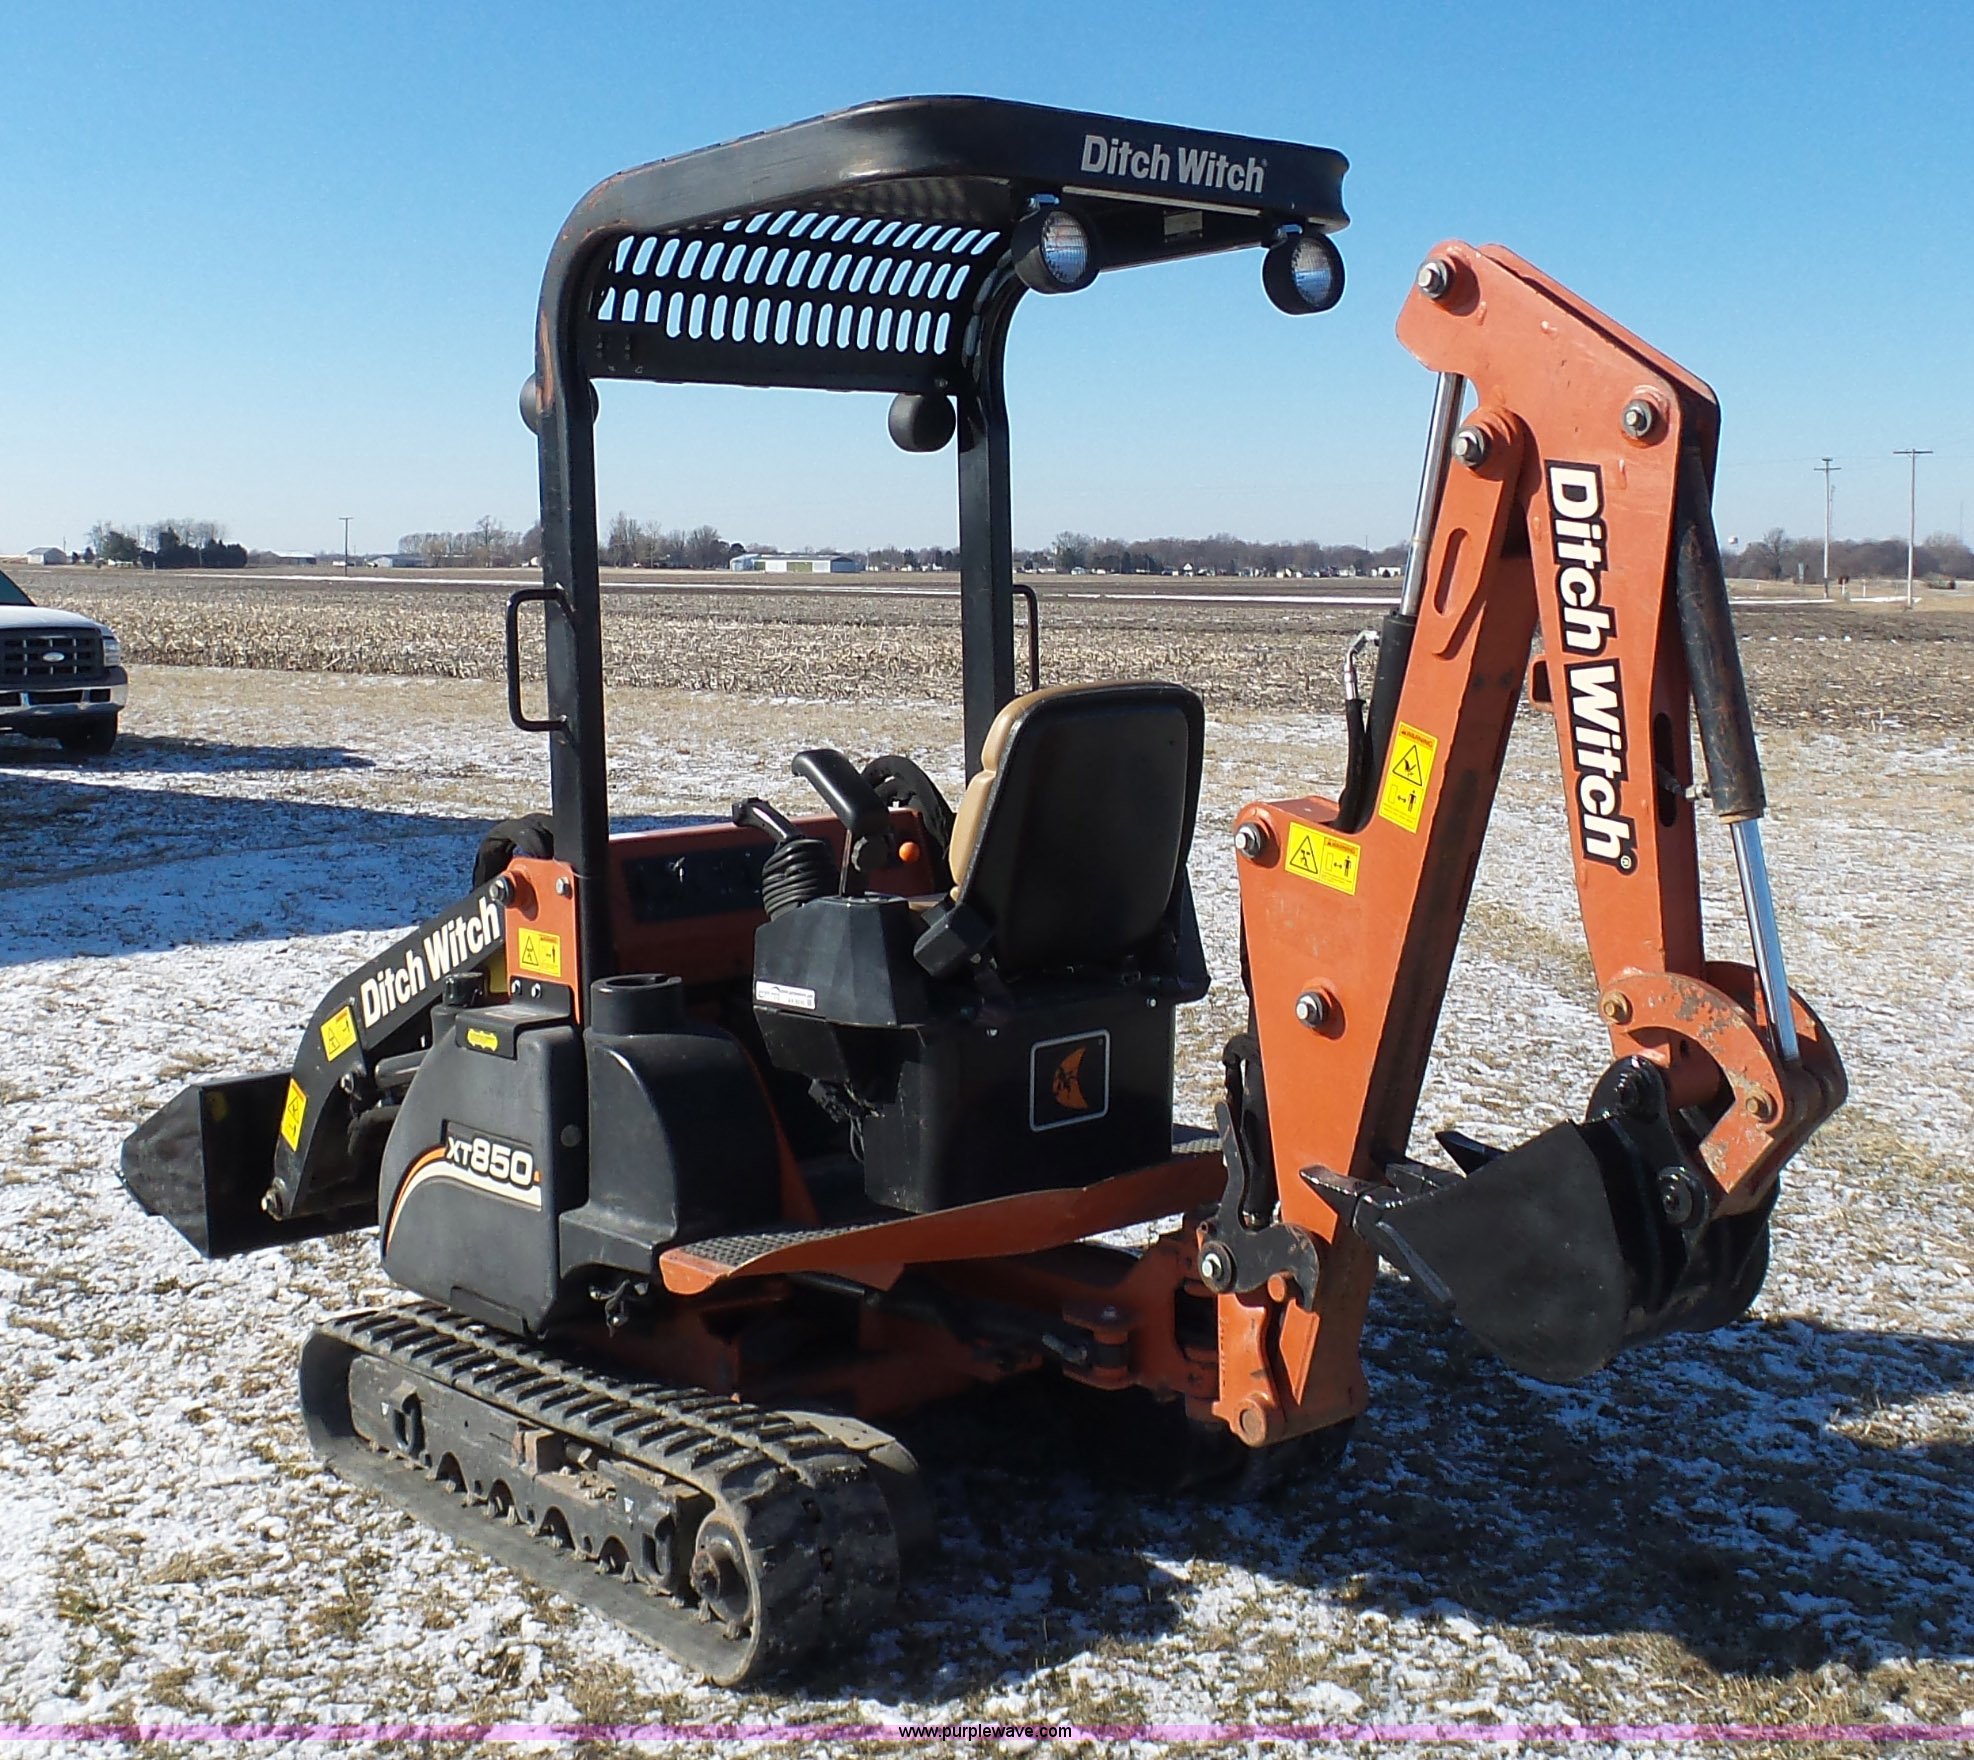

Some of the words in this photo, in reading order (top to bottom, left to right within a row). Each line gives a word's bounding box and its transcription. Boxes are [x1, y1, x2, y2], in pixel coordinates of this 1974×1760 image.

[1081, 134, 1171, 181] Ditch
[1177, 147, 1265, 193] Witch
[1549, 465, 1611, 652] Ditch
[1569, 665, 1631, 858] Witch
[360, 949, 426, 1028] Ditch
[423, 896, 501, 981] Witch
[446, 1136, 534, 1187] XT850
